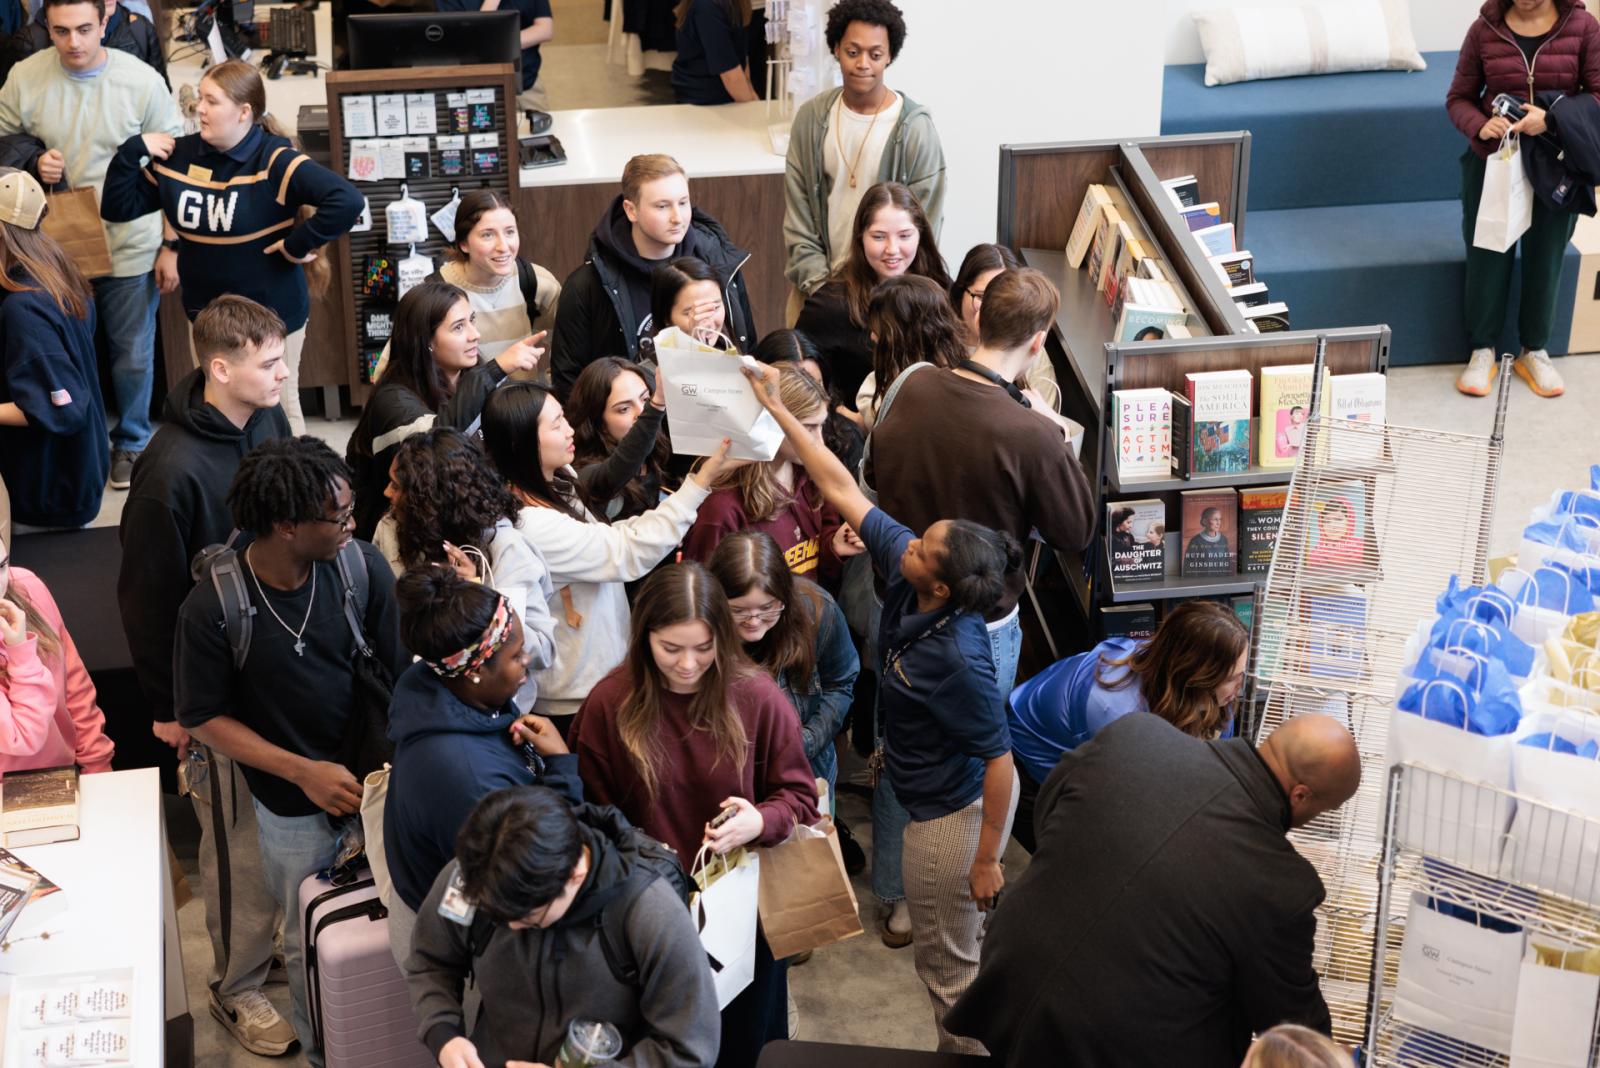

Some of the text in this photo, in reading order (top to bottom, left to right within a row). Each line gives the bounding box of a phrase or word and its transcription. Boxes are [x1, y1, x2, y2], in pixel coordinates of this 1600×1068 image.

[178, 189, 239, 232] GW
[370, 314, 390, 322] DARE
[681, 384, 697, 396] GW
[1199, 402, 1248, 411] AMERICA
[1114, 549, 1162, 559] DAUGHTER
[1113, 562, 1162, 572] AUSCHWITZ
